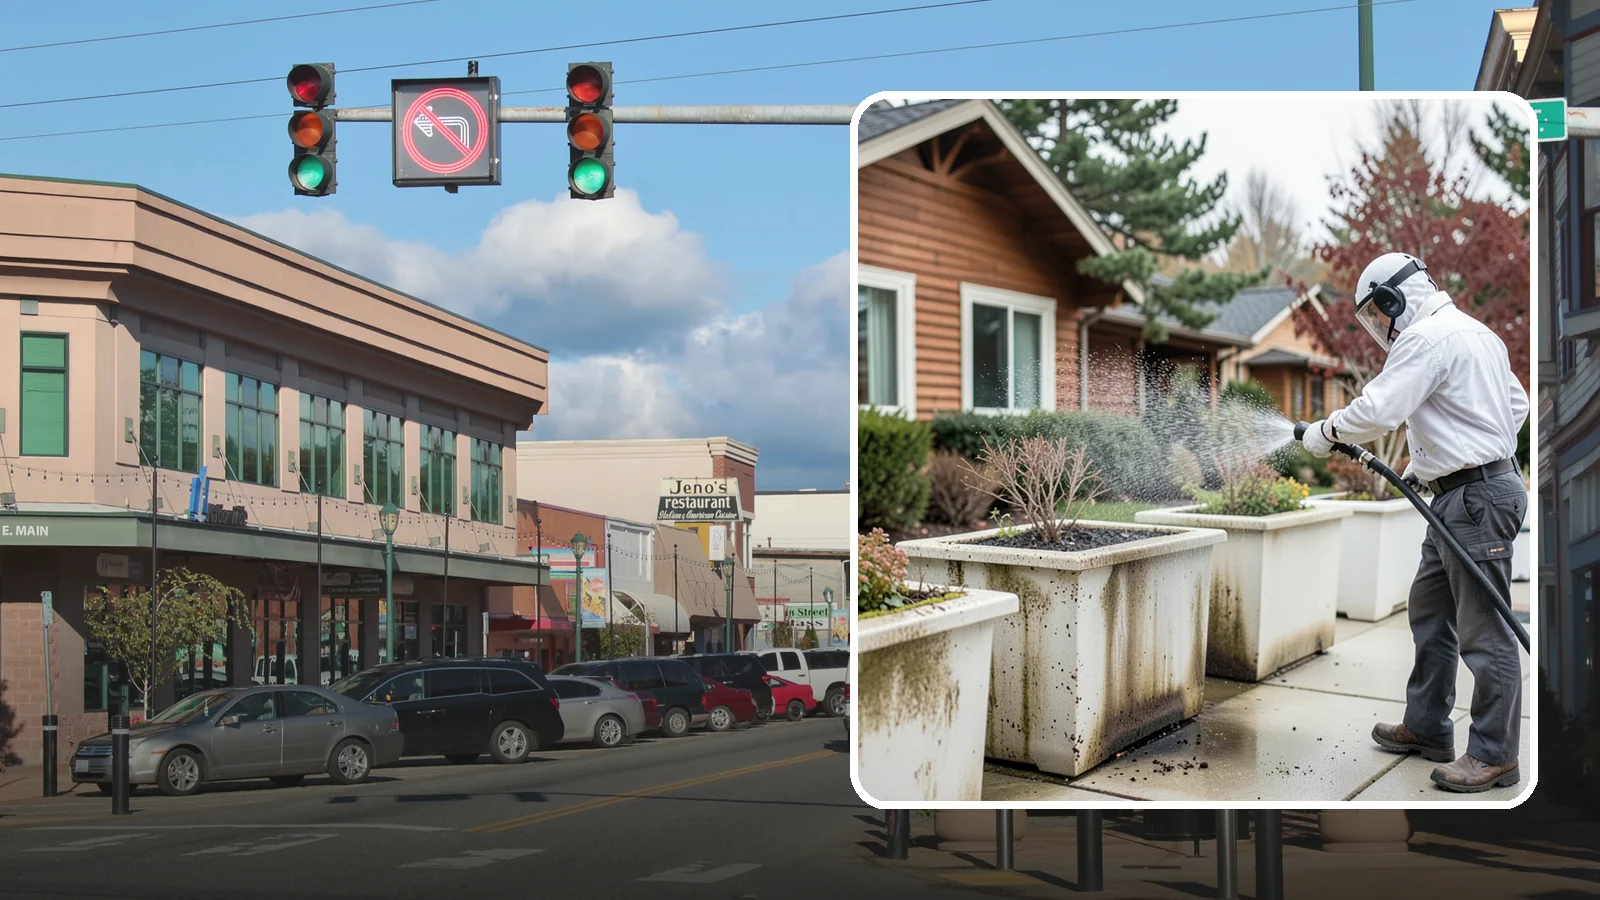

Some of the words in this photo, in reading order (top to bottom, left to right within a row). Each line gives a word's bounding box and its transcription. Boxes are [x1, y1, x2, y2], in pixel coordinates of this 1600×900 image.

[669, 480, 727, 494] Jeno's
[665, 496, 731, 509] restaurant
[659, 510, 682, 519] Italian
[686, 510, 715, 520] American
[715, 509, 738, 519] Cuisine
[2, 525, 13, 536] E.
[15, 525, 49, 537] MAIN
[785, 607, 795, 617] in
[797, 607, 828, 617] Street
[791, 620, 823, 628] lass
